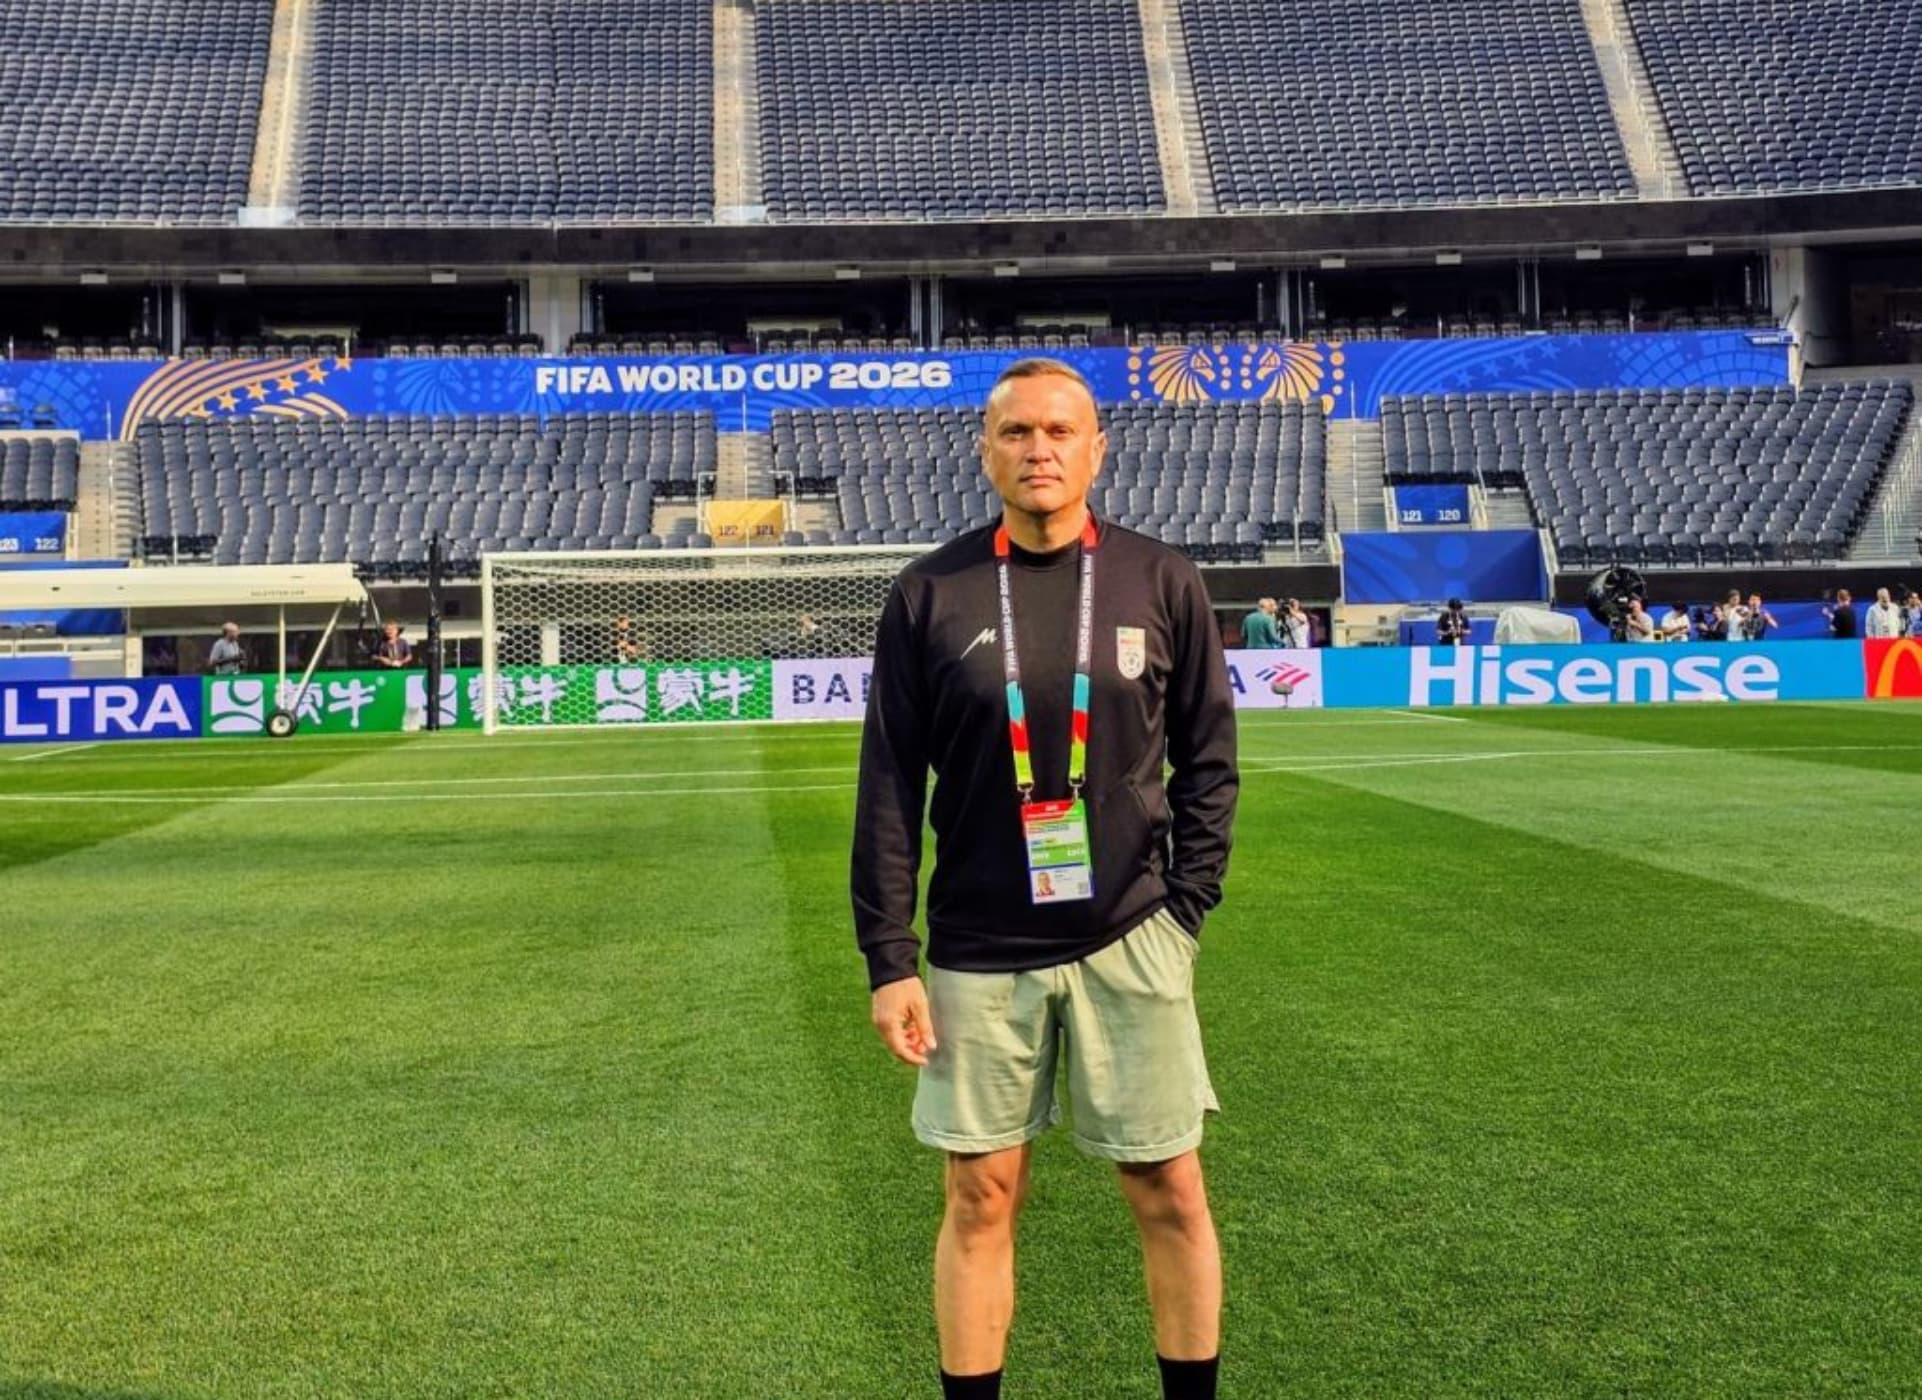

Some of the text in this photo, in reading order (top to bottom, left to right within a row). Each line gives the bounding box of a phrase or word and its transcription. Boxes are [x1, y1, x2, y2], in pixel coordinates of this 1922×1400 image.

[535, 361, 953, 395] FIFA WORLD CUP 2026
[1402, 509, 1422, 522] 121
[34, 537, 59, 550] 122
[1003, 615, 1014, 650] WORLD
[655, 667, 755, 716] 蒙牛
[1408, 645, 1780, 706] Hisense
